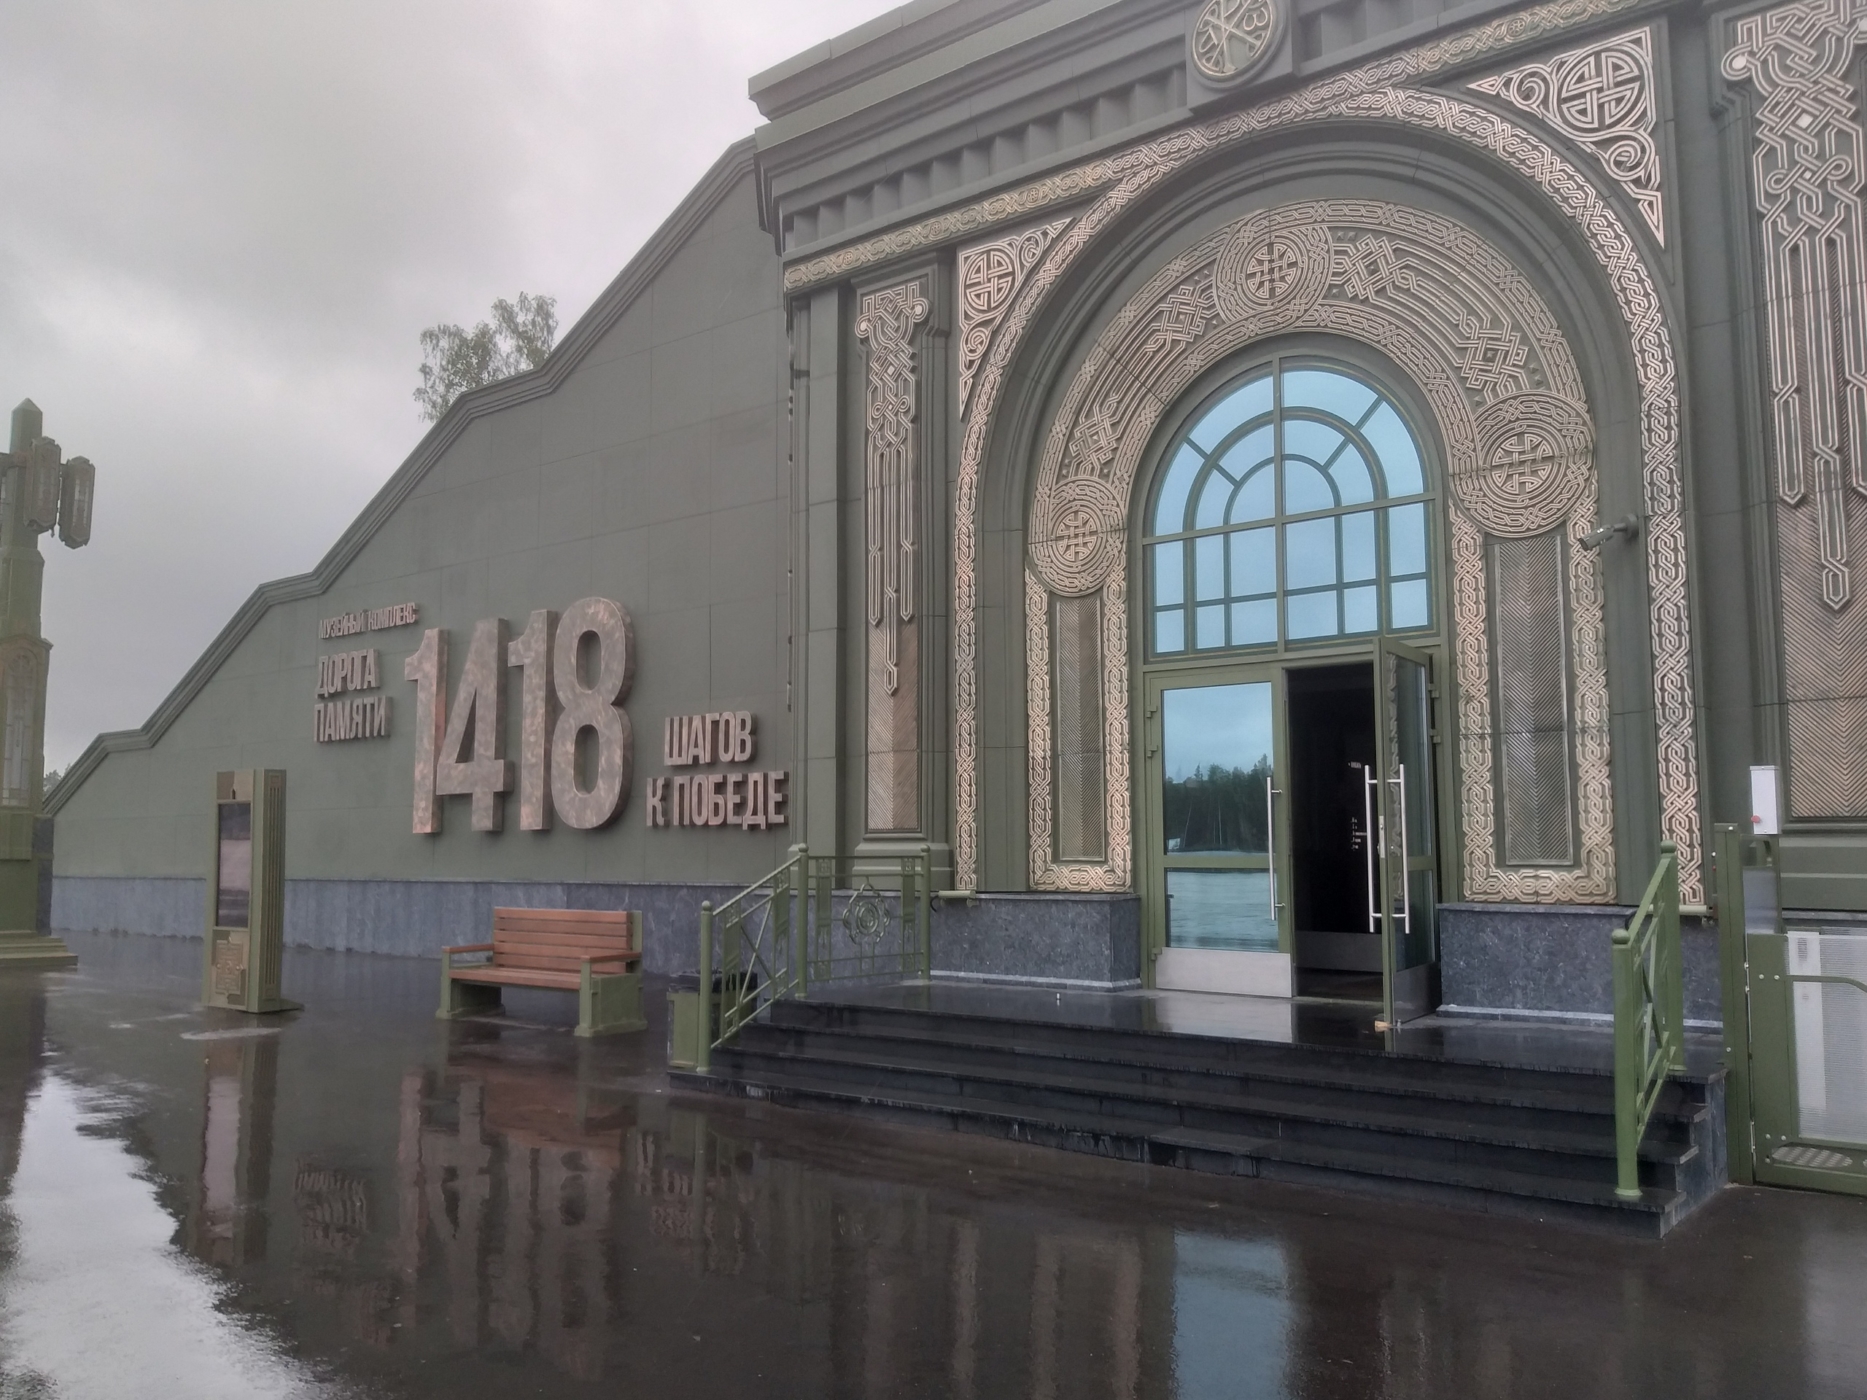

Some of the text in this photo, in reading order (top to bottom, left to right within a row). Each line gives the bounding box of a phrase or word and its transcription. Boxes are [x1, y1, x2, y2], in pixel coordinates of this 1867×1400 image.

[319, 602, 417, 639] МУЗЕЙНЫЙ КОМПЛЕКС
[315, 648, 378, 699] ДОРОГА
[314, 696, 390, 743] ПАМЯТИ
[405, 597, 633, 834] 1418
[664, 710, 755, 766] ШАГОВ
[646, 770, 788, 830] К ПОБЕДЕ
